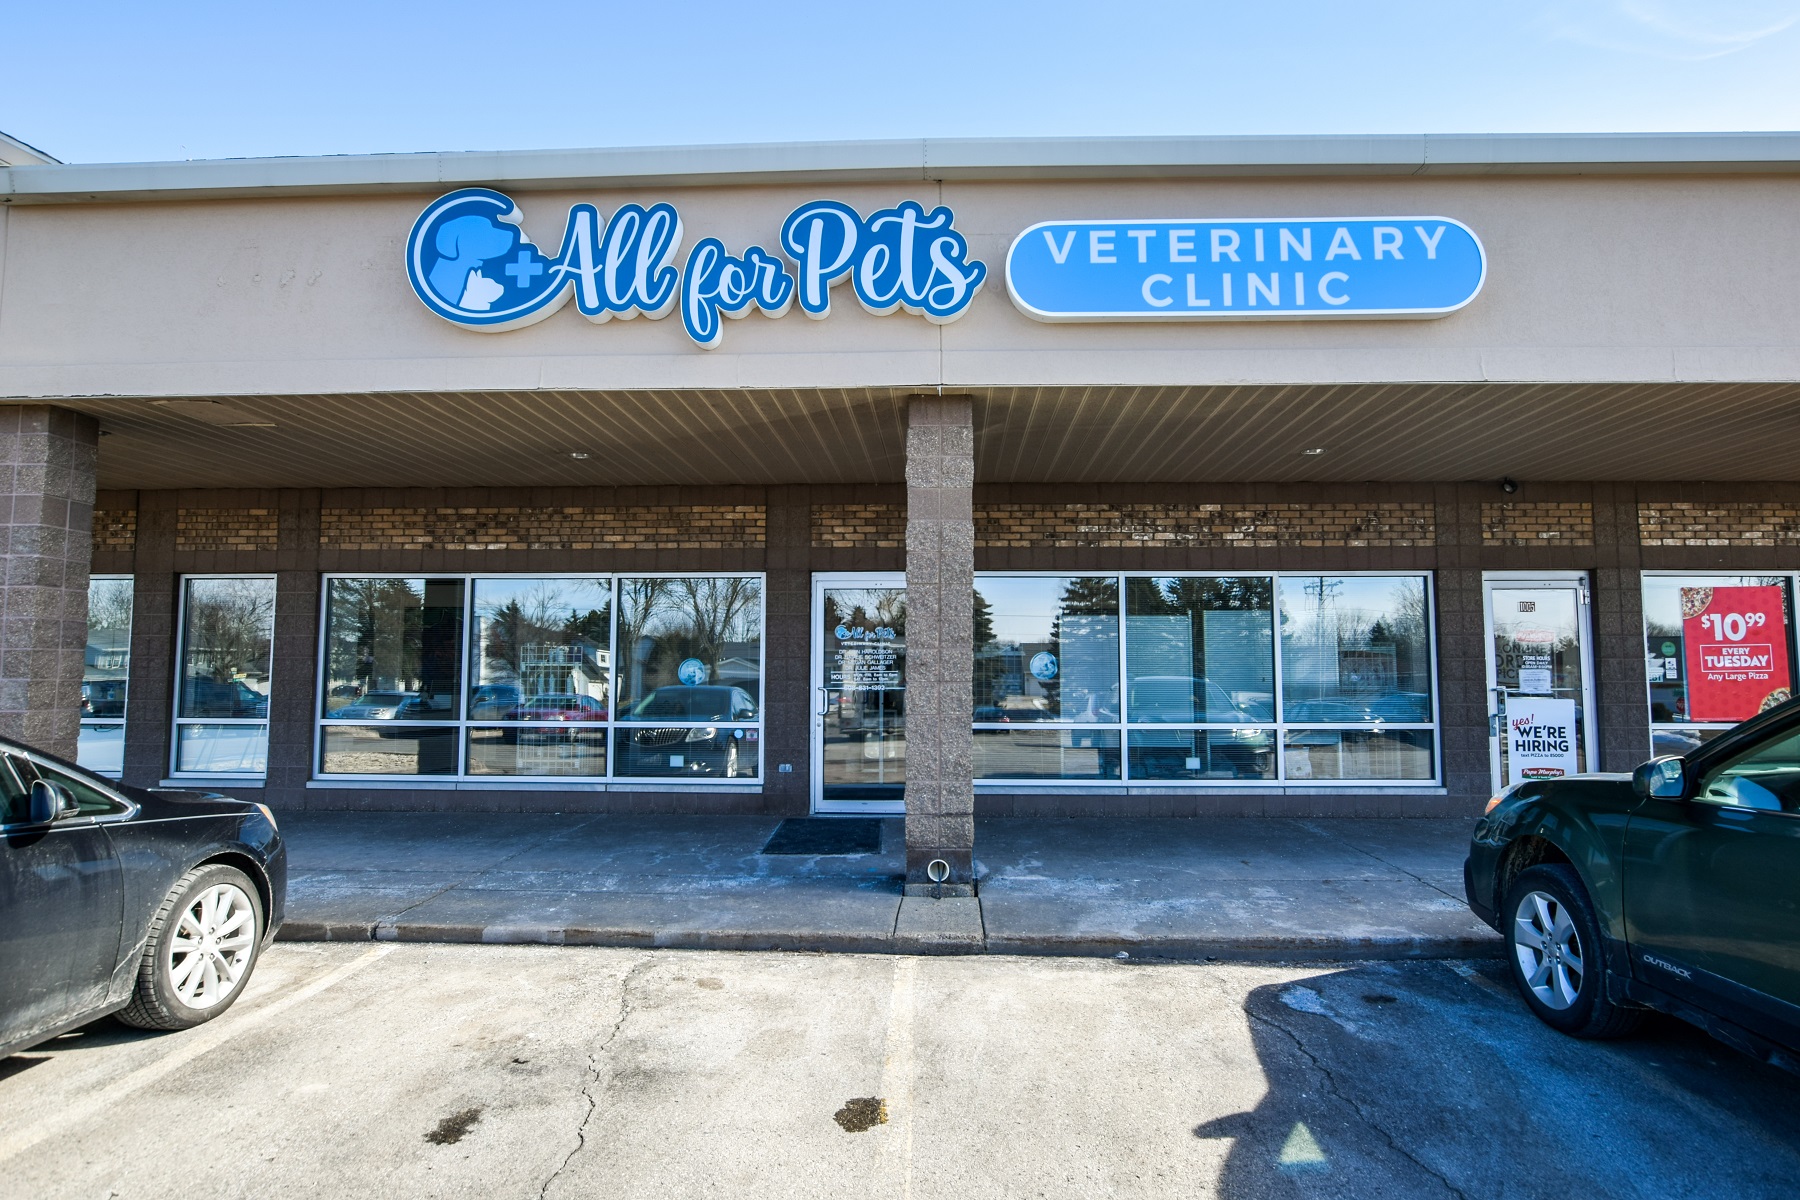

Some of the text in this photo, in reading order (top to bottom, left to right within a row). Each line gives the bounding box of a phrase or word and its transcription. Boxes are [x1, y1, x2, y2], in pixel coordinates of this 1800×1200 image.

[1043, 226, 1447, 264] VETERINARY
[548, 207, 979, 335] All for Pets
[1142, 272, 1351, 307] CLINIC
[1722, 647, 1750, 655] EVERY
[1705, 655, 1769, 667] TUESDAY
[1707, 672, 1769, 682] Any Large Pizza
[1512, 714, 1534, 730] yes!
[1518, 725, 1567, 738] WE'RE
[1515, 740, 1569, 752] HIRING
[1538, 769, 1564, 777] Murphy's
[1643, 954, 1692, 980] OUTBACK
